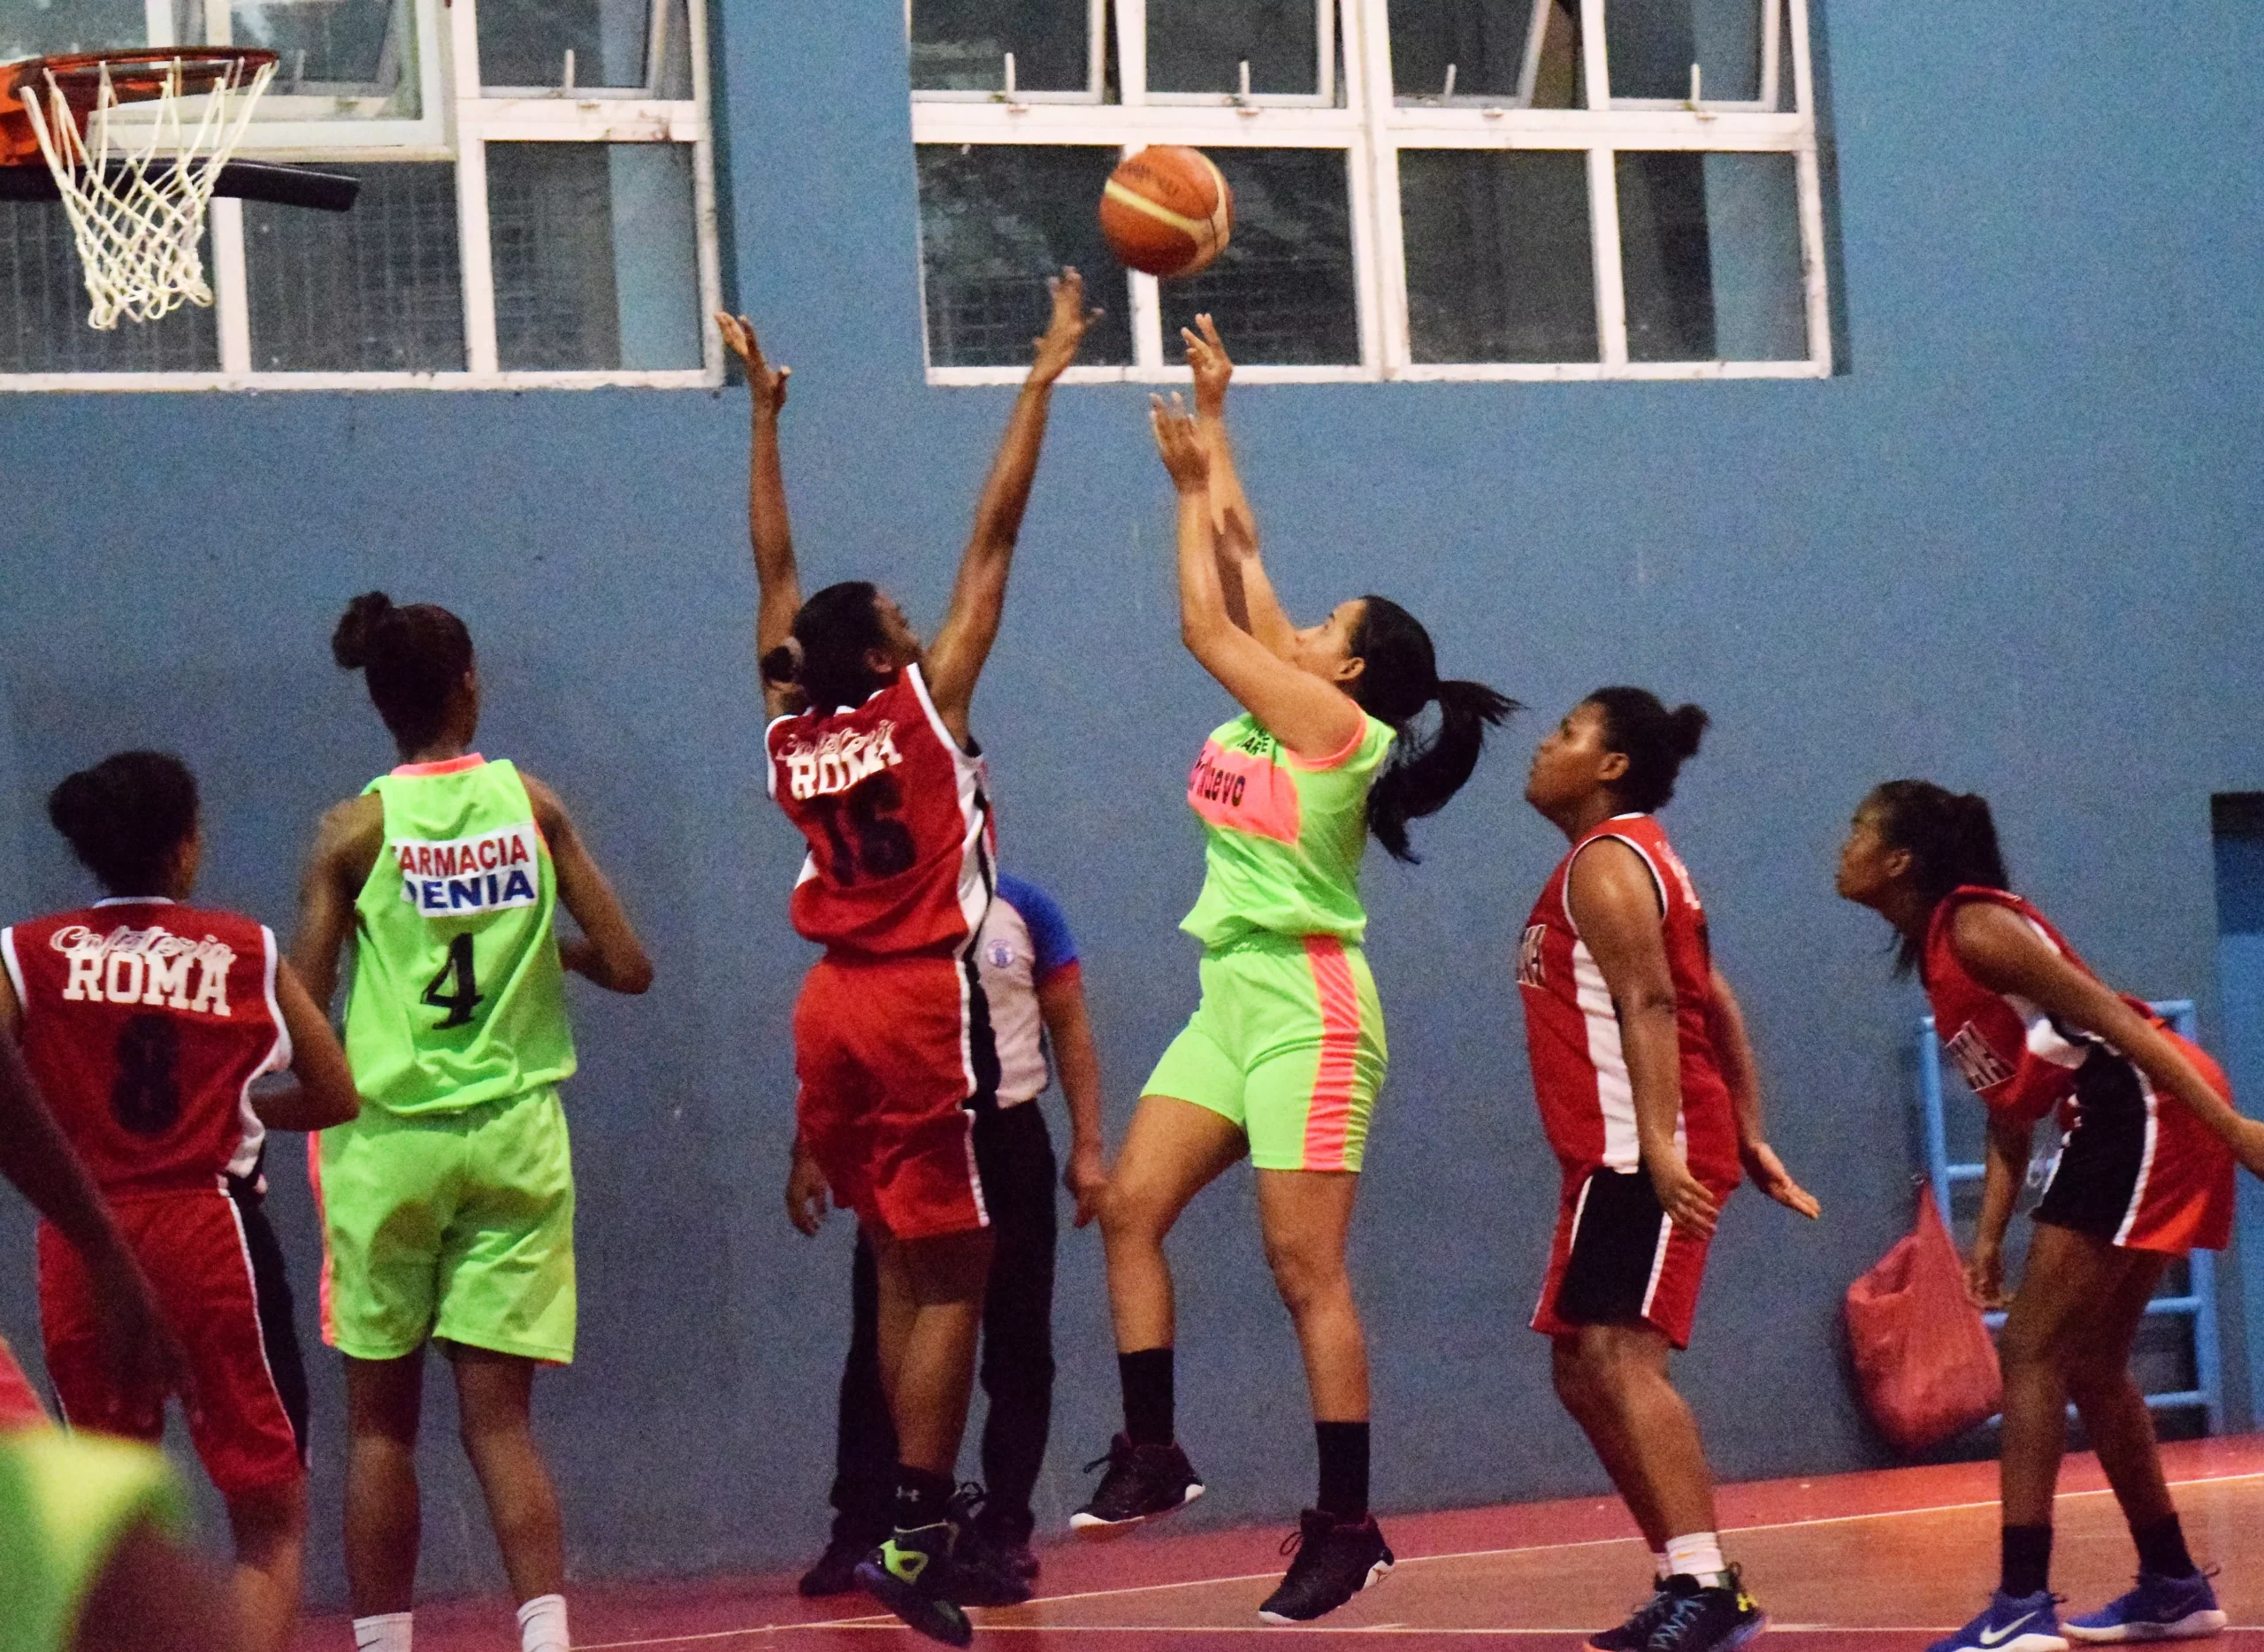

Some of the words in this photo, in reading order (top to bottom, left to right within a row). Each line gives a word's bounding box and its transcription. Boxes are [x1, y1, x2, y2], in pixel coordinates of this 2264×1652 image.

[391, 834, 530, 876] ARMACIA
[62, 949, 233, 1017] ROMA
[420, 932, 485, 1030] 4
[109, 1014, 184, 1135] 8
